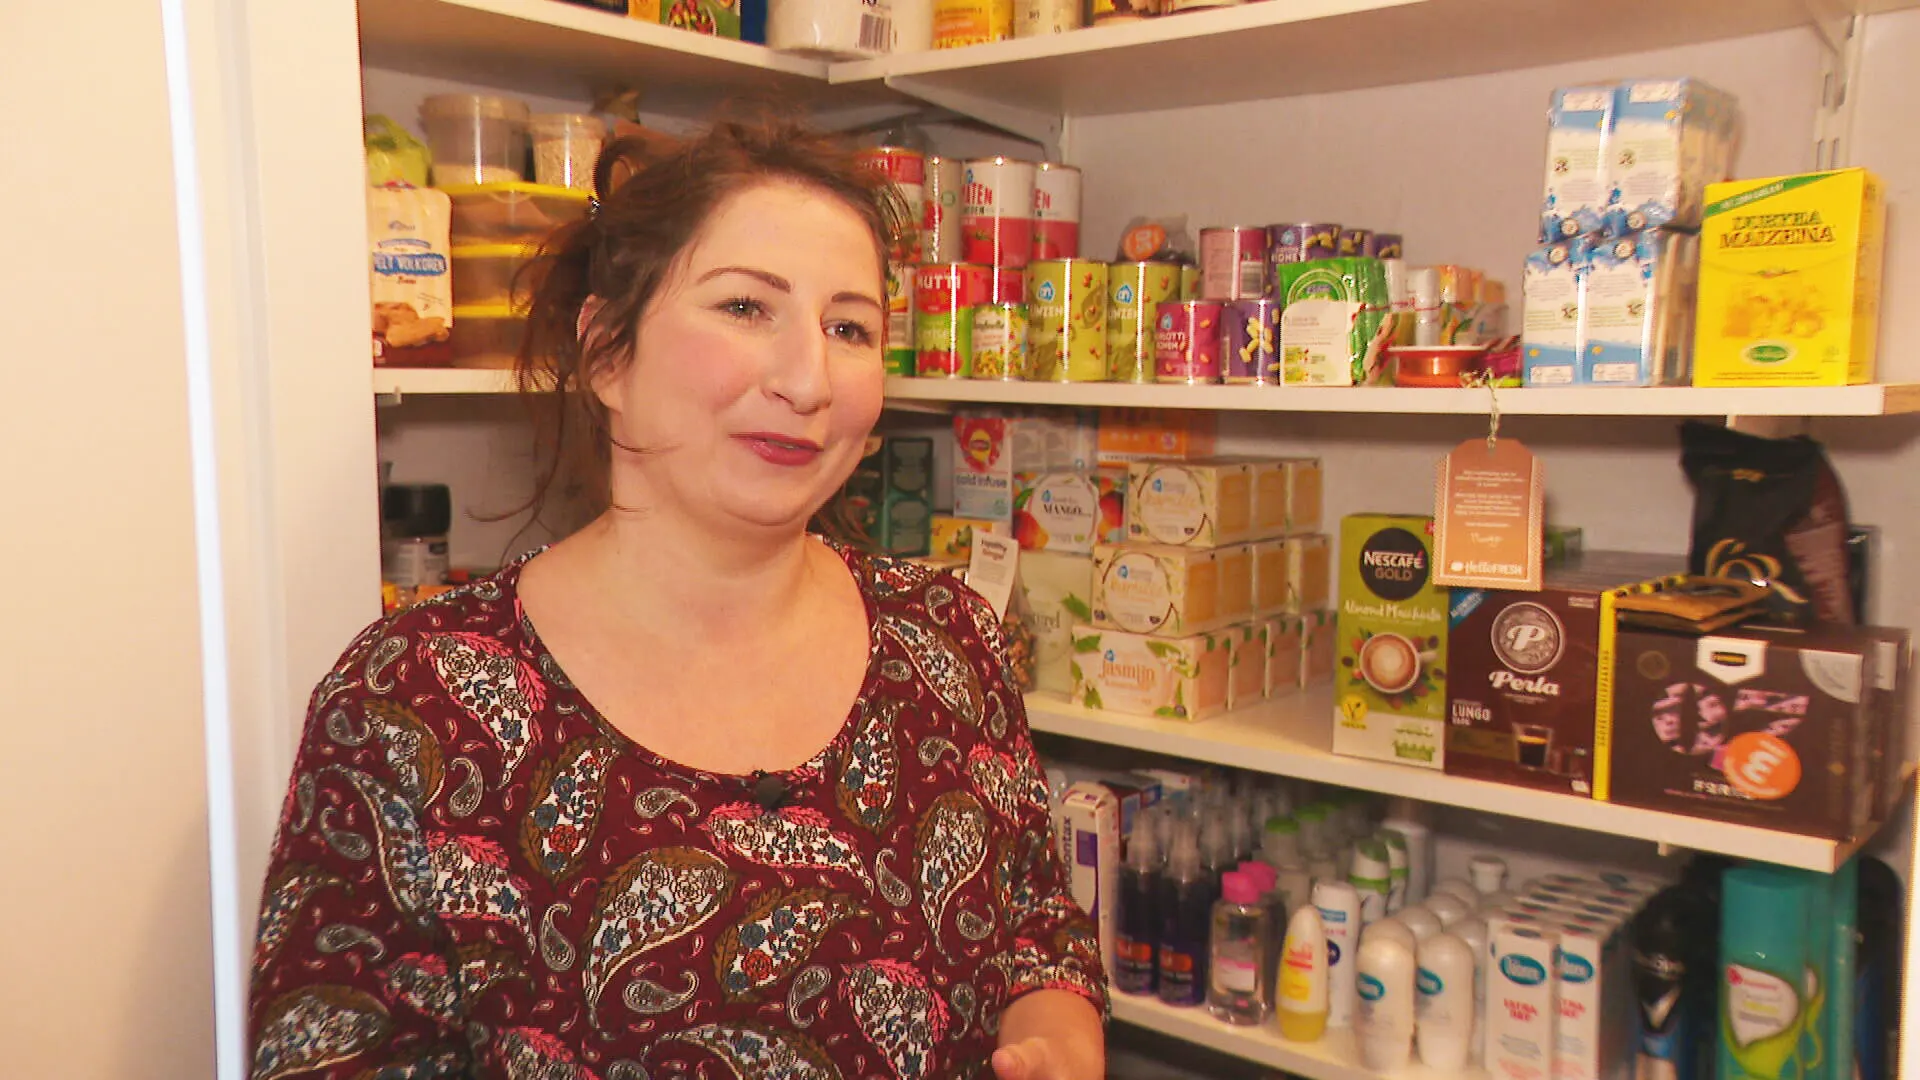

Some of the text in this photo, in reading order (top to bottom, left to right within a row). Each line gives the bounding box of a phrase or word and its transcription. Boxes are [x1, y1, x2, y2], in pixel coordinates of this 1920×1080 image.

[1720, 226, 1836, 249] MAIZENA
[917, 275, 961, 290] MUTTI
[1043, 504, 1082, 515] MANGO
[1364, 549, 1425, 569] NESCAFÉ
[1375, 568, 1413, 581] GOLD
[1488, 670, 1561, 695] Perla
[1452, 703, 1492, 721] LUNGO
